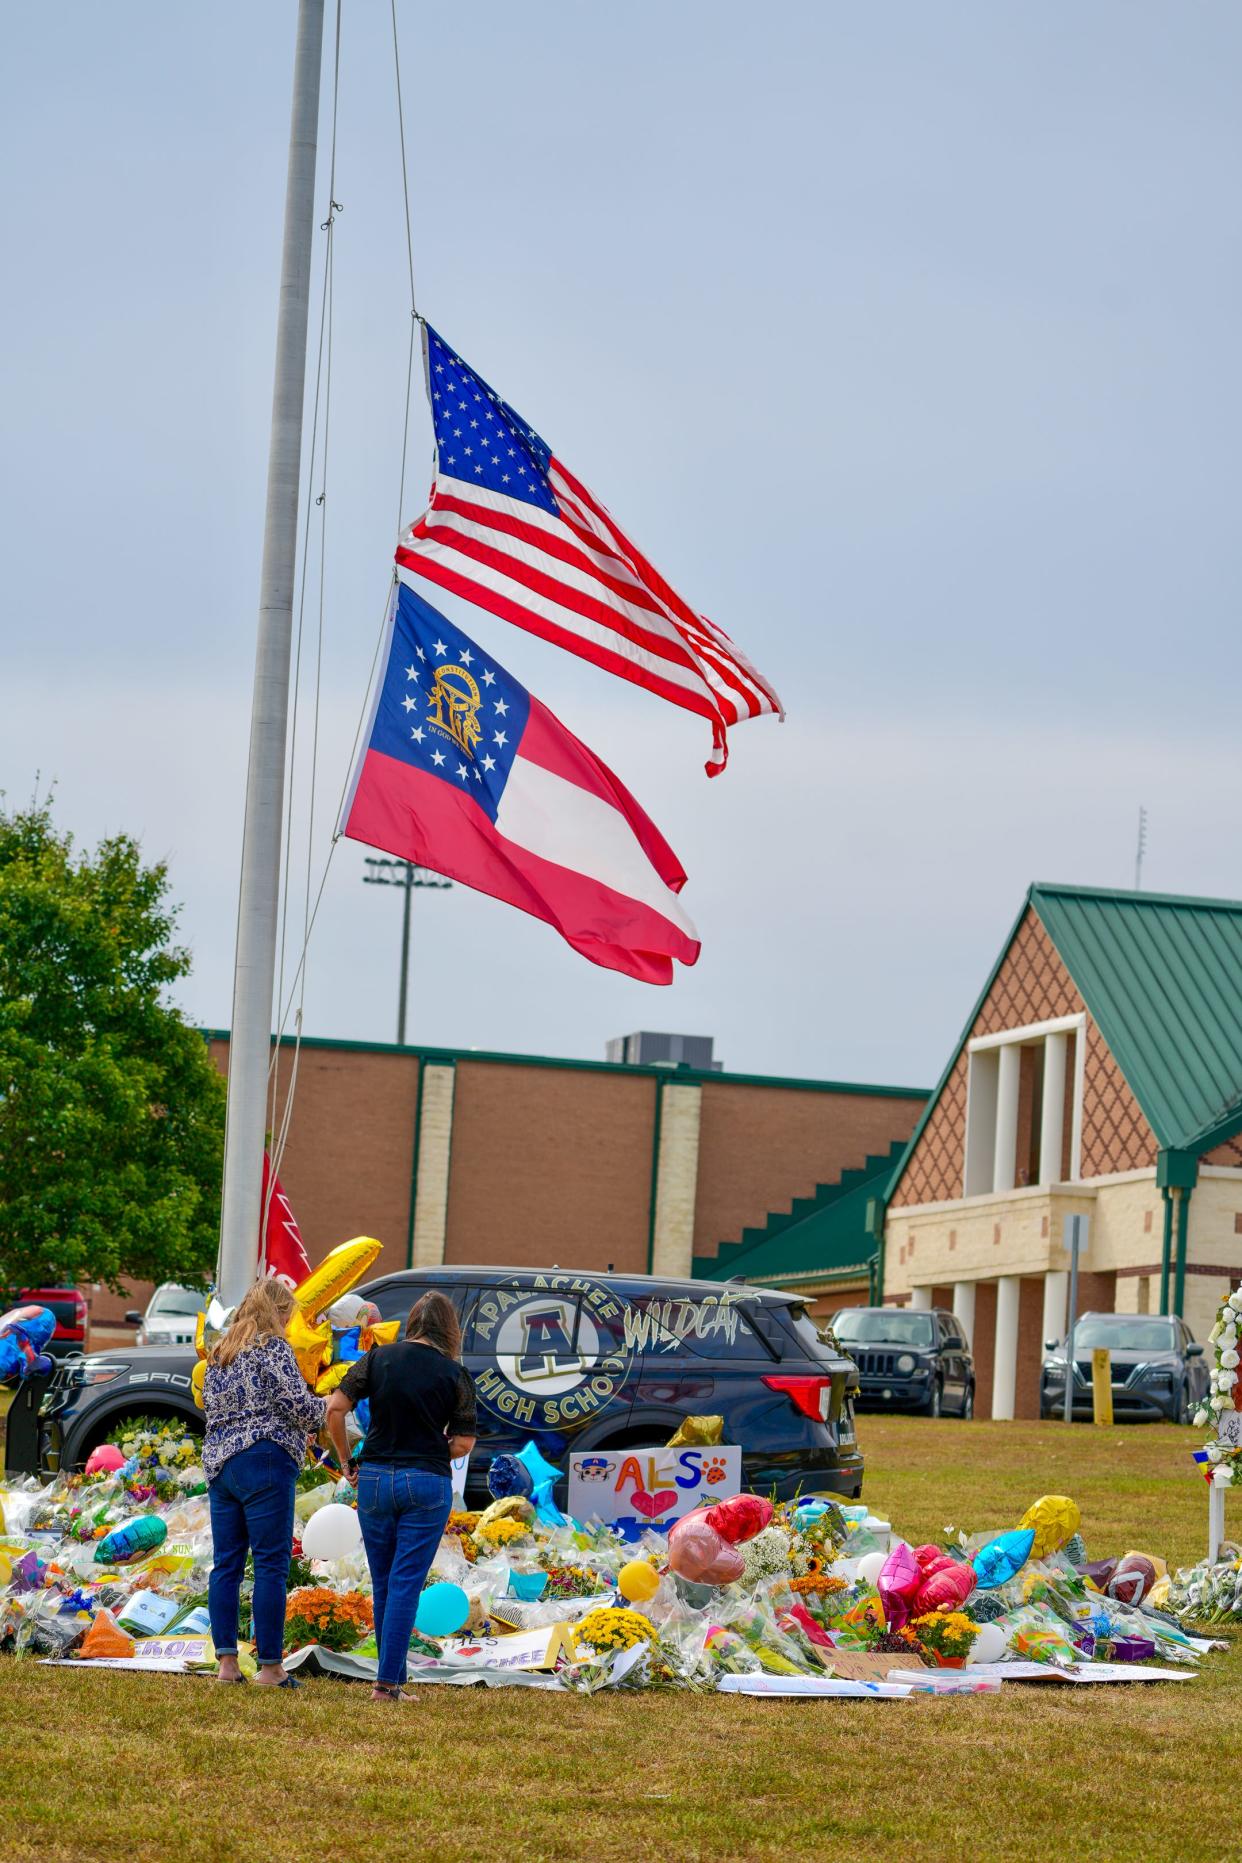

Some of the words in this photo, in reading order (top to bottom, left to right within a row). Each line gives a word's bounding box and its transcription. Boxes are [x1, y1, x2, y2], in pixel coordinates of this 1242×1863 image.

[472, 1275, 620, 1341] APALACHEE
[515, 1304, 587, 1384] A
[129, 1372, 192, 1388] SRO
[474, 1367, 536, 1423] HIGH
[543, 1343, 628, 1424] SCHOOL
[614, 1451, 703, 1493] ALS
